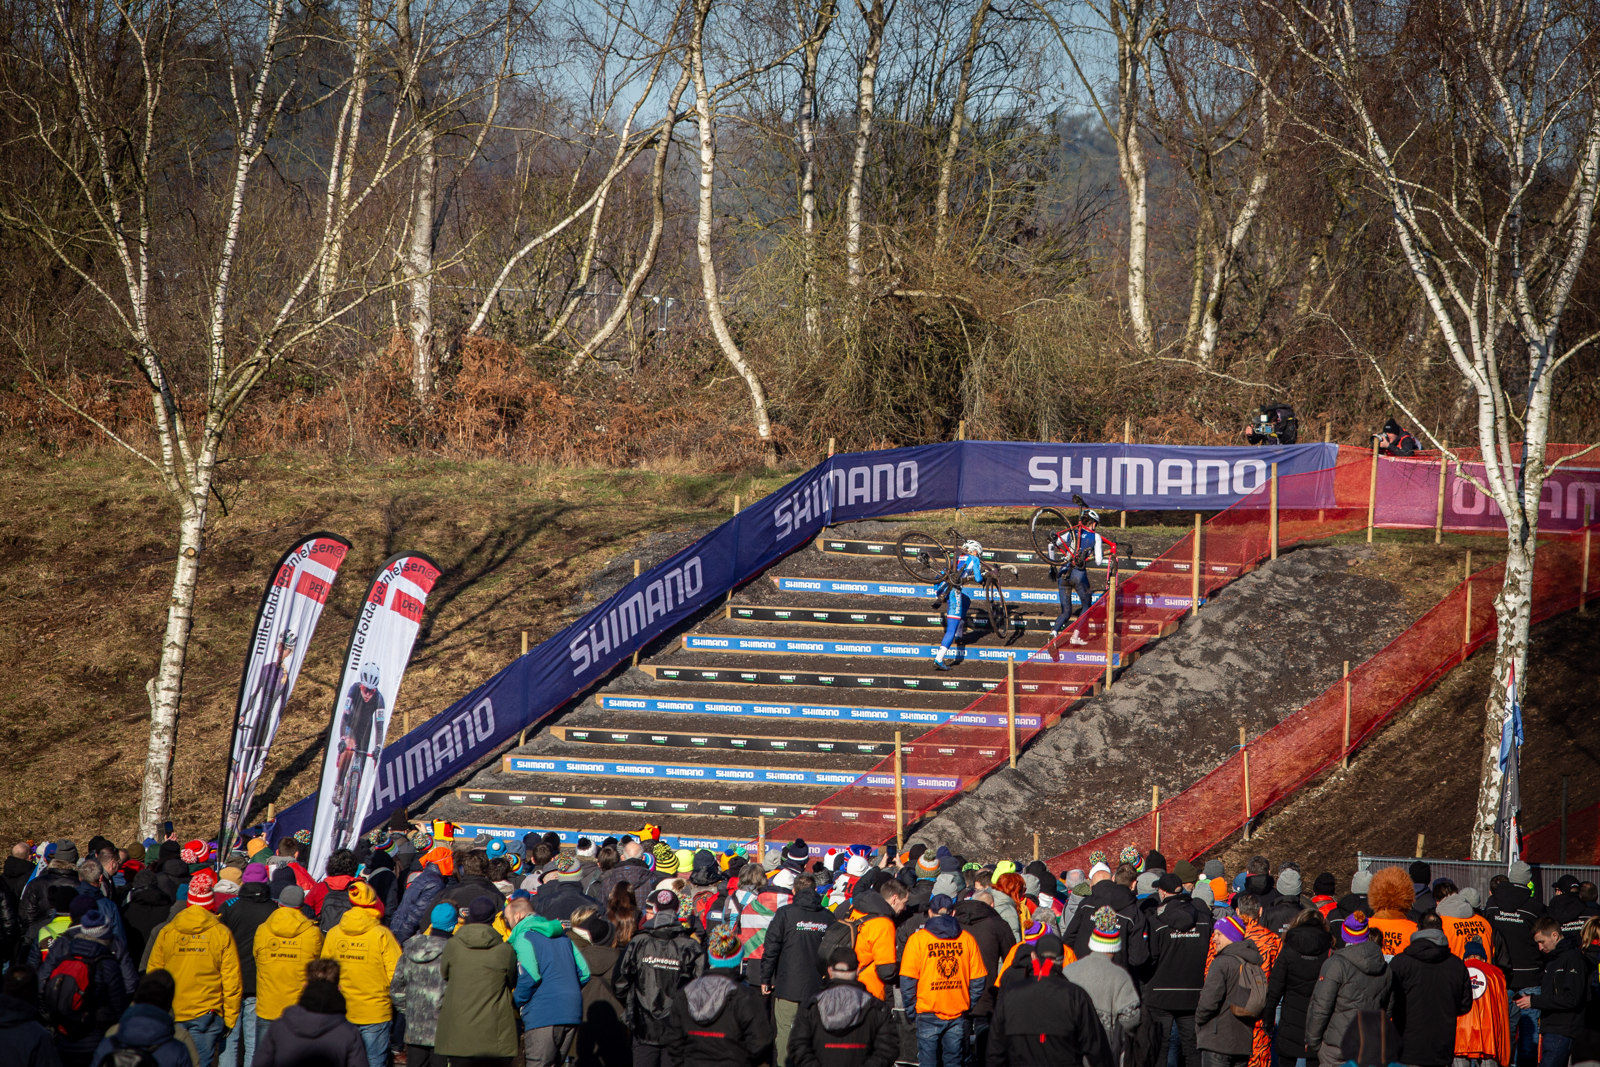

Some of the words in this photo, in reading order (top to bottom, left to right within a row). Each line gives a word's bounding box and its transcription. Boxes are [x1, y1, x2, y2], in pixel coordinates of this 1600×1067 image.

[1028, 456, 1267, 495] SHIMANO
[774, 460, 918, 542] SHIMANO
[309, 580, 327, 596] DEN
[784, 581, 822, 589] SHIMANO
[831, 583, 868, 592] SHIMANO
[878, 585, 915, 594] SHIMANO
[1020, 592, 1058, 601] SHIMANO
[401, 599, 421, 615] DEN
[569, 556, 703, 677] SHIMANO
[692, 638, 728, 647] SHIMANO
[740, 640, 776, 649] SHIMANO
[787, 642, 824, 651] SHIMANO
[834, 644, 872, 653] SHIMANO
[882, 646, 920, 655] SHIMANO
[979, 650, 1016, 659] SHIMANO
[608, 699, 646, 708] SHIMANO
[656, 701, 694, 710] SHIMANO
[704, 703, 742, 712] SHIMANO
[753, 706, 790, 714] SHIMANO
[802, 708, 840, 716] SHIMANO
[850, 710, 888, 719] SHIMANO
[900, 712, 938, 721] SHIMANO
[950, 715, 987, 723] SHIMANO
[516, 761, 554, 770] SHIMANO
[566, 763, 604, 772] SHIMANO
[616, 766, 654, 774] SHIMANO
[666, 768, 704, 776] SHIMANO
[716, 770, 754, 778] SHIMANO
[766, 772, 804, 781] SHIMANO
[816, 774, 856, 783] SHIMANO
[917, 778, 956, 787] SHIMANO
[678, 839, 718, 849] SHIMANO
[796, 920, 828, 930] challenge
[1453, 920, 1484, 929] ORANGE
[1456, 928, 1486, 936] ARMY
[1384, 932, 1402, 940] NGE
[1384, 938, 1402, 946] MY
[928, 942, 962, 950] ORANGE
[928, 950, 964, 958] ARMY
